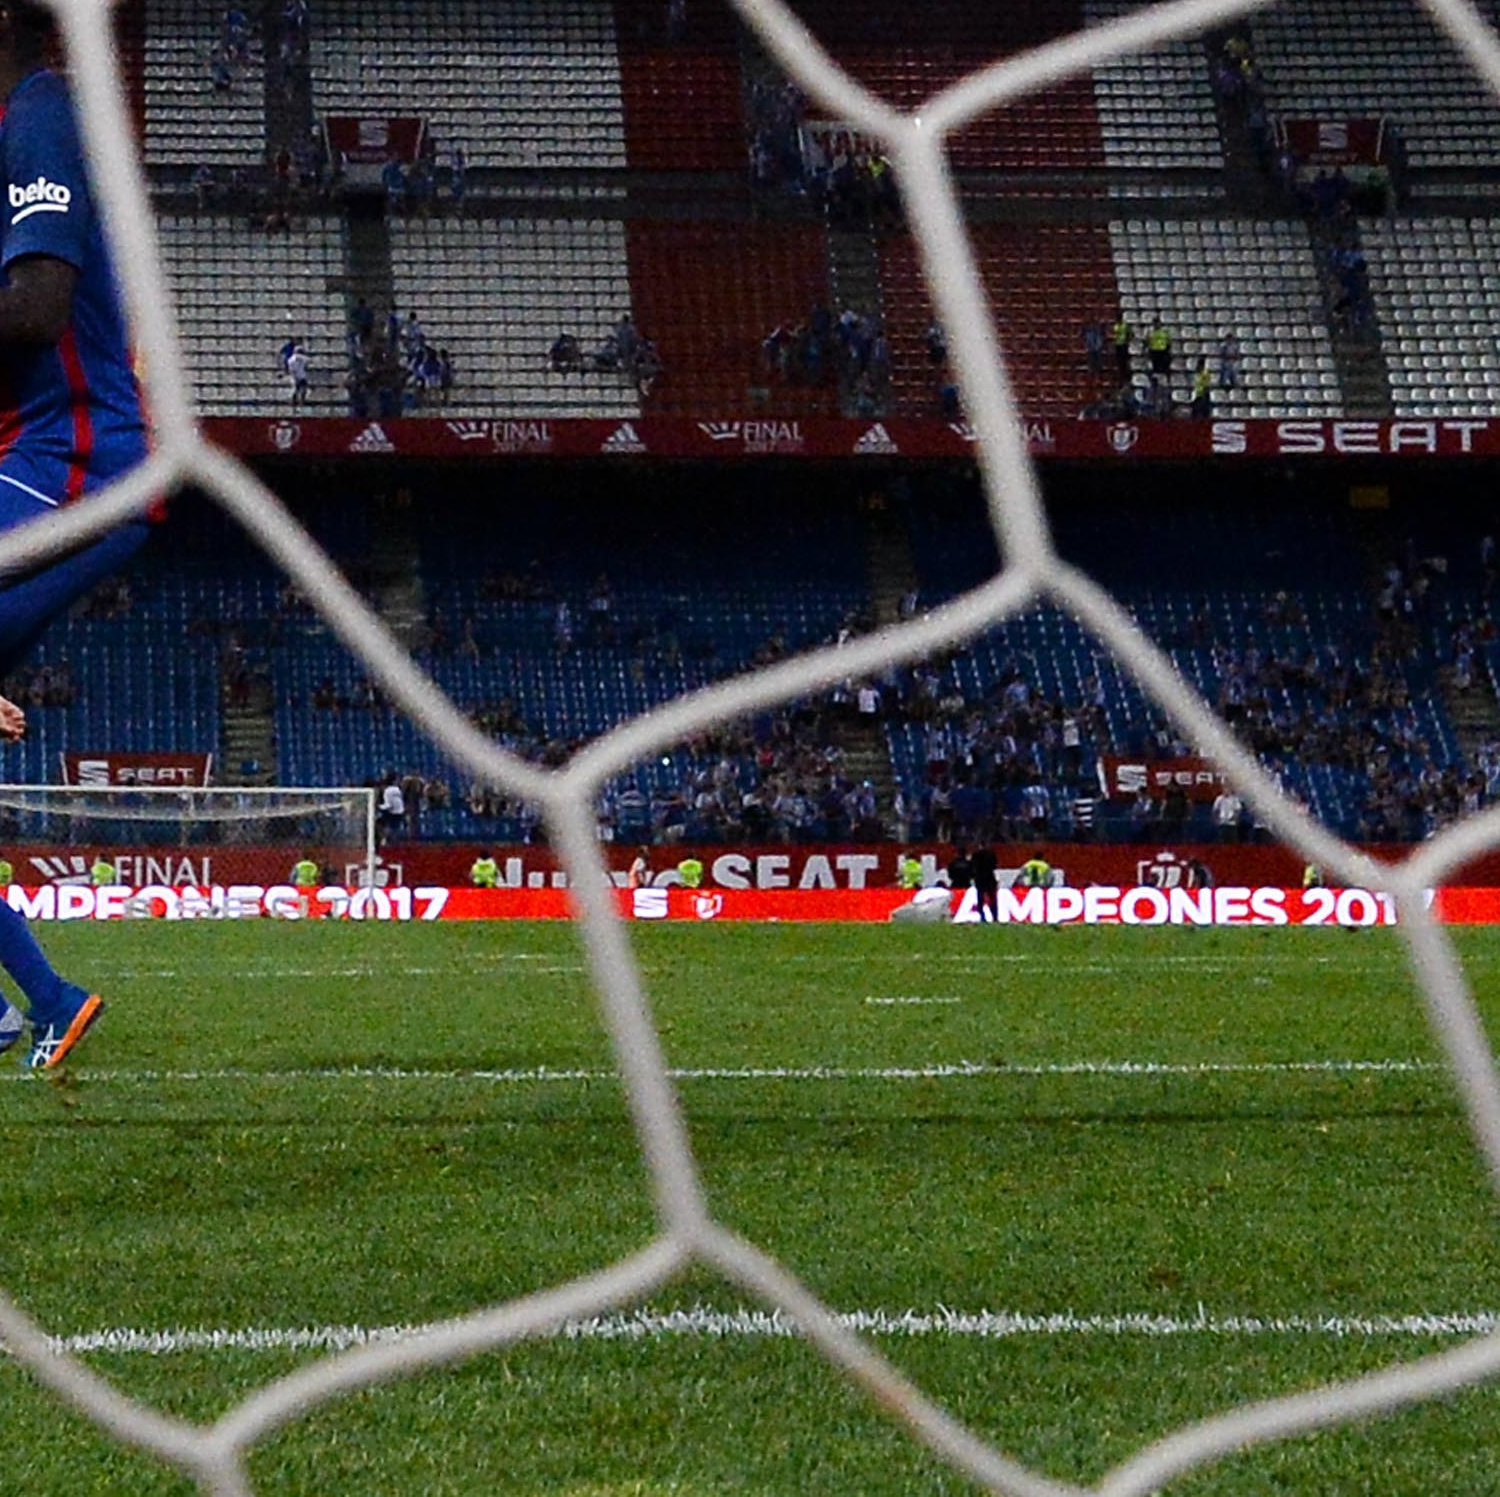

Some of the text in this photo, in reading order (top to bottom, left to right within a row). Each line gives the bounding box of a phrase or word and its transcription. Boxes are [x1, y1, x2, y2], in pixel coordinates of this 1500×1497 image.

[8, 176, 71, 207] beko
[492, 421, 551, 441] FINAL
[742, 421, 802, 440] FINAL
[1277, 421, 1488, 453] SEAT
[7, 883, 449, 920] MPEONES 2017
[1301, 886, 1436, 926] 201
